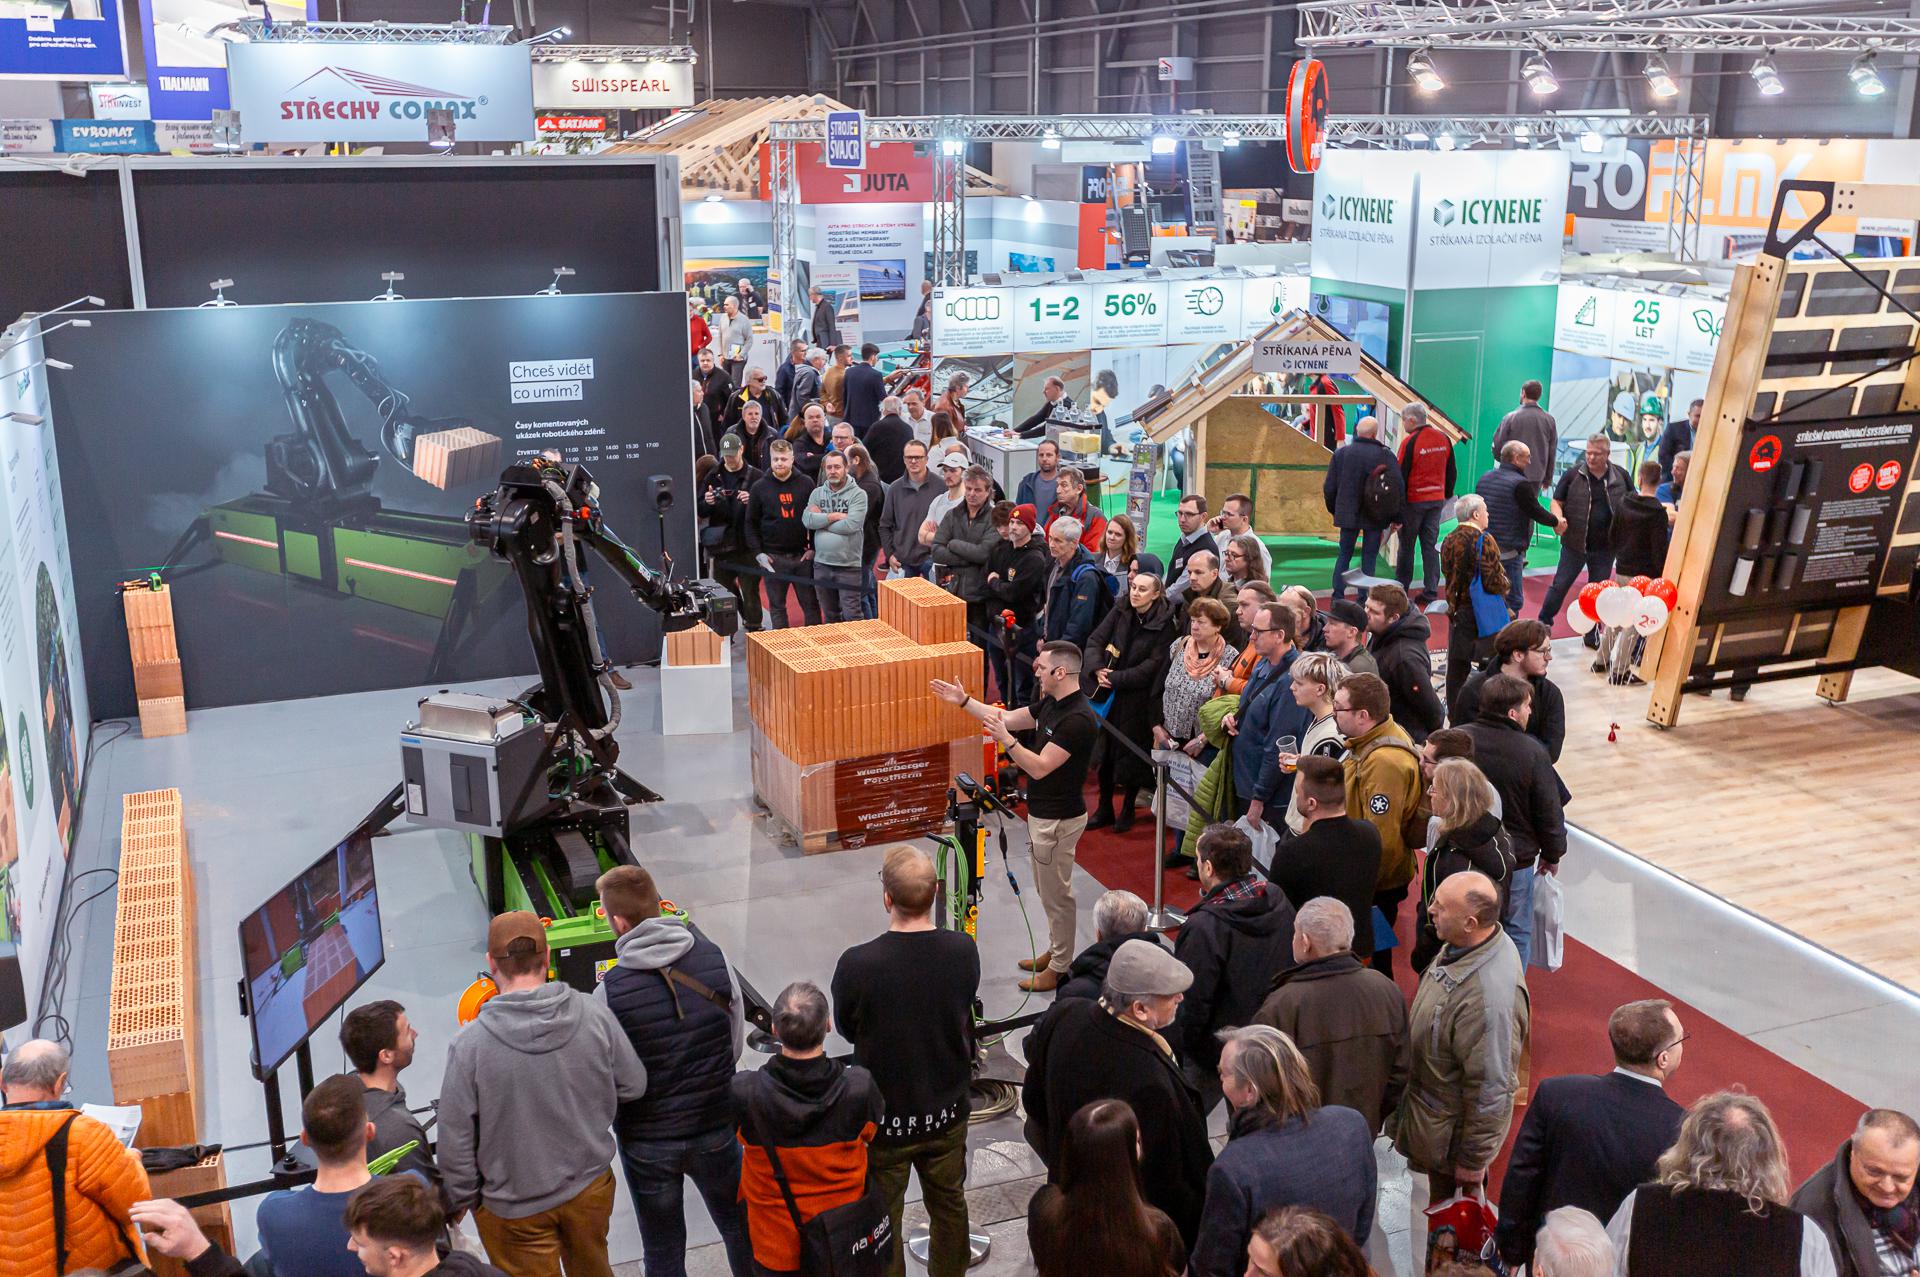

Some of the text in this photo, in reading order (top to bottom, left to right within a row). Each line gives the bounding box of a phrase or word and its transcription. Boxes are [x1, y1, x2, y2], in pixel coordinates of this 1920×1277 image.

[159, 76, 209, 91] THALMANN
[572, 78, 670, 92] SWISSPEARL
[281, 96, 476, 119] STŘECHY COMAX
[830, 136, 860, 159] ŠVAJCR
[864, 173, 909, 192] JUTA
[1340, 196, 1393, 224] ICYNENE
[1462, 198, 1541, 224] ICYNENE
[1476, 232, 1518, 246] IZOLAČNÍ
[1520, 232, 1542, 243] PĚNA
[1104, 292, 1156, 316] 56%
[1633, 299, 1660, 324] 25
[1635, 327, 1655, 338] LET
[1263, 344, 1352, 356] STŘÍKANÁ PĚNA
[512, 363, 591, 378] Chceš vidět
[1295, 360, 1328, 369] ICYNENE
[514, 384, 580, 399] co umím?
[515, 418, 588, 430] Časy komentovaných
[516, 428, 606, 440] ukázek robotického zdění:
